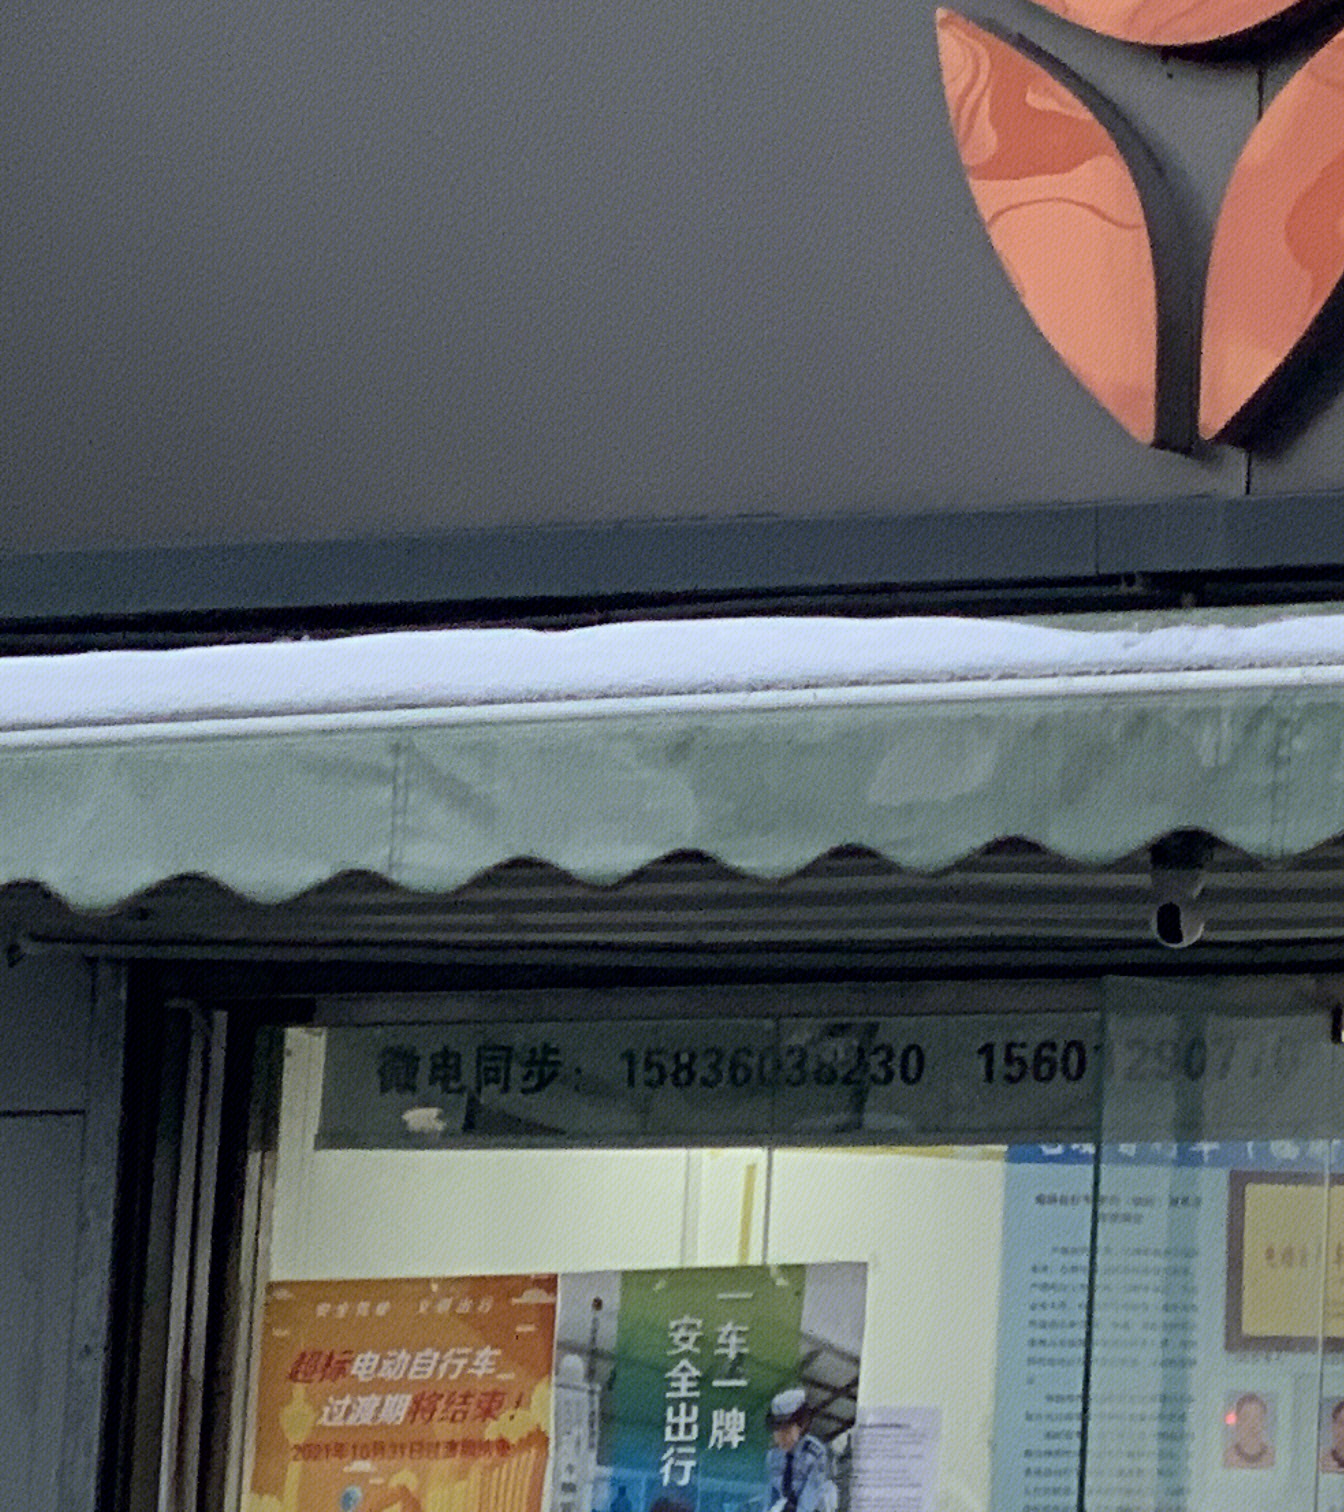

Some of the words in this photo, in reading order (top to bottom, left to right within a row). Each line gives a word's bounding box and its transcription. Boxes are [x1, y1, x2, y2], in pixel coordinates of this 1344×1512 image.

[289, 1345, 501, 1384] 超标电动自行车
[660, 1315, 704, 1487] 安全出行
[708, 1292, 754, 1450] 一车一牌
